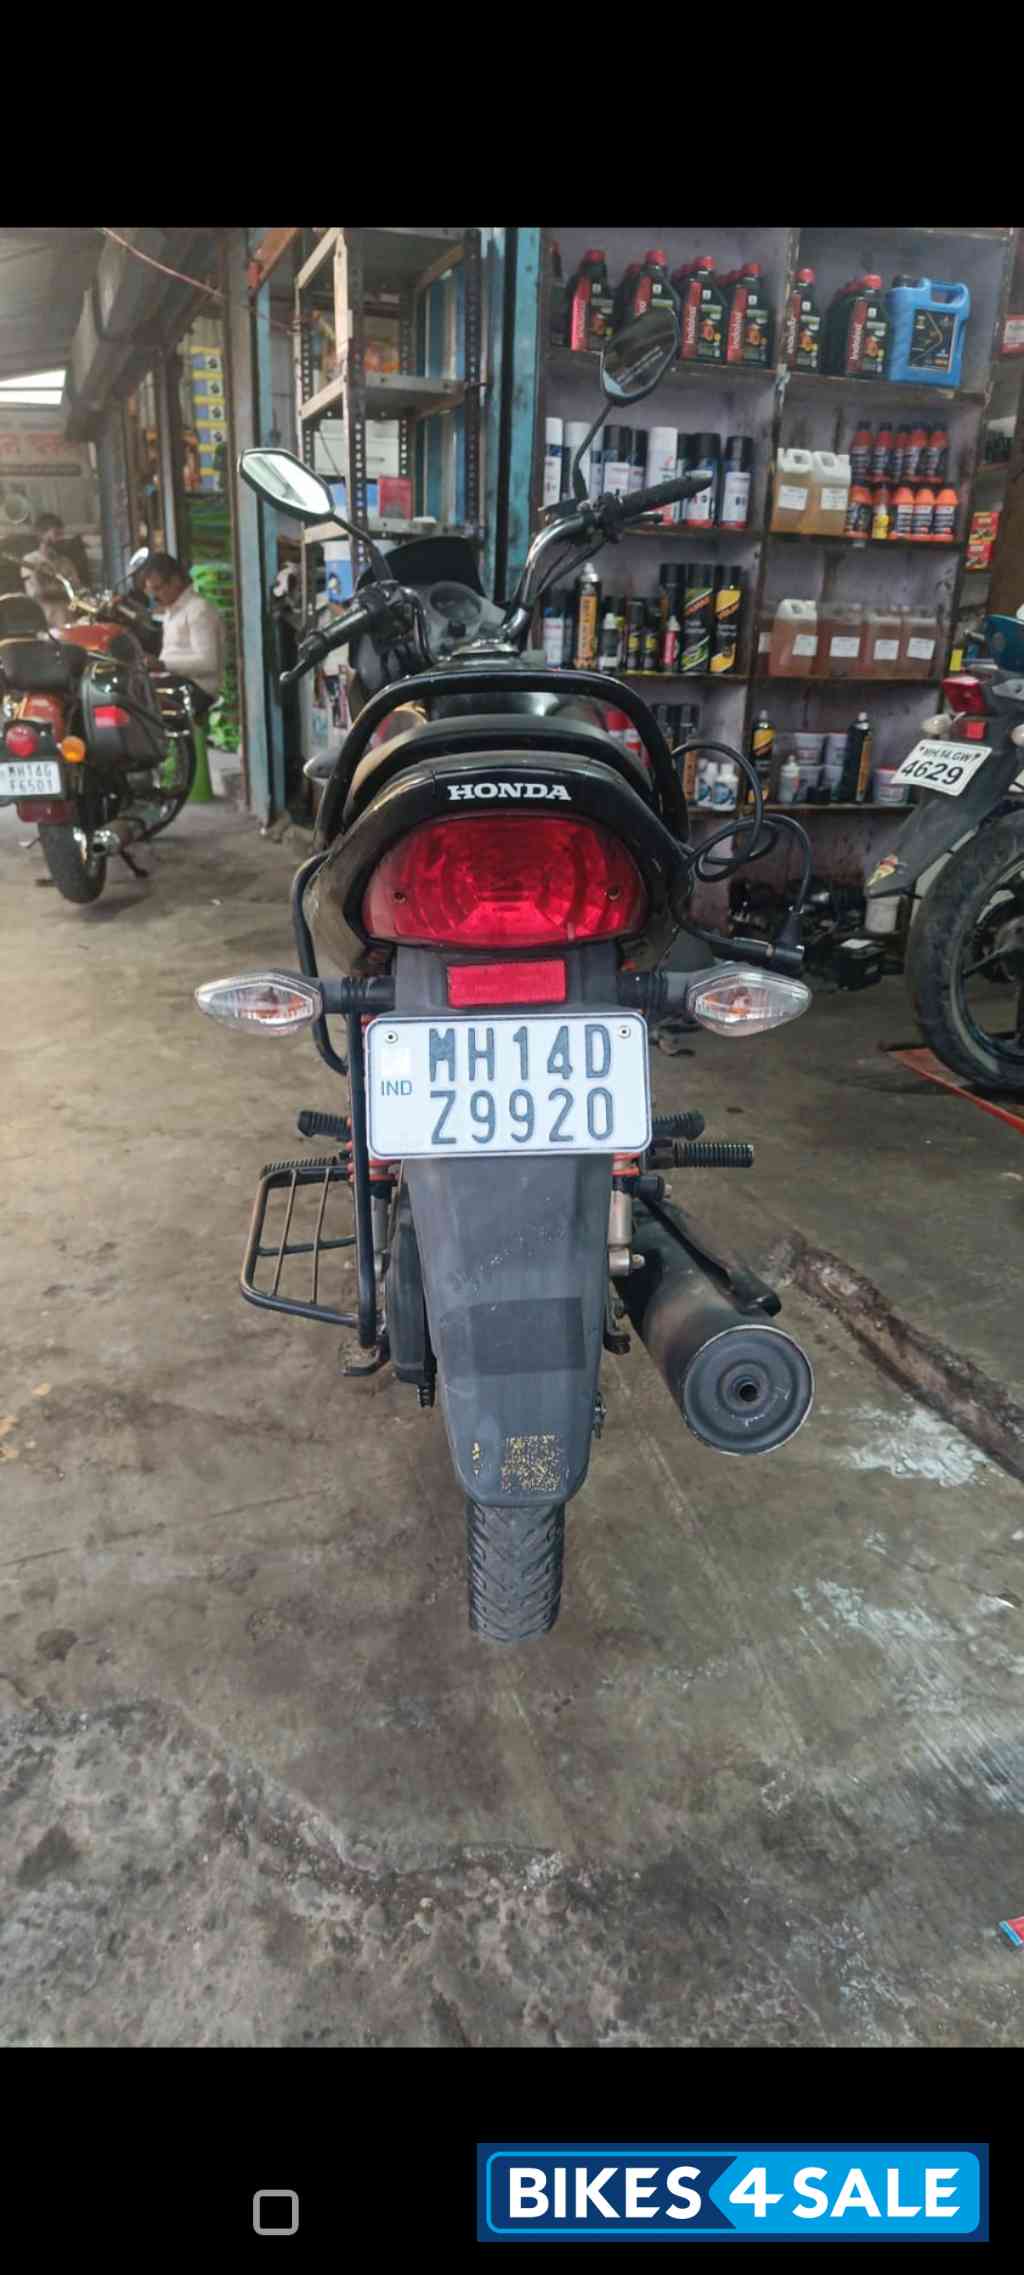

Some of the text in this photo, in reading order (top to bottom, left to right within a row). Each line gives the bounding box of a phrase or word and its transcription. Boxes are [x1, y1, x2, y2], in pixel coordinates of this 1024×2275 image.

[901, 761, 964, 785] 4629
[447, 782, 573, 801] HONDA
[428, 1023, 613, 1082] MH14D
[380, 1079, 413, 1096] IND
[429, 1086, 615, 1146] Z9920
